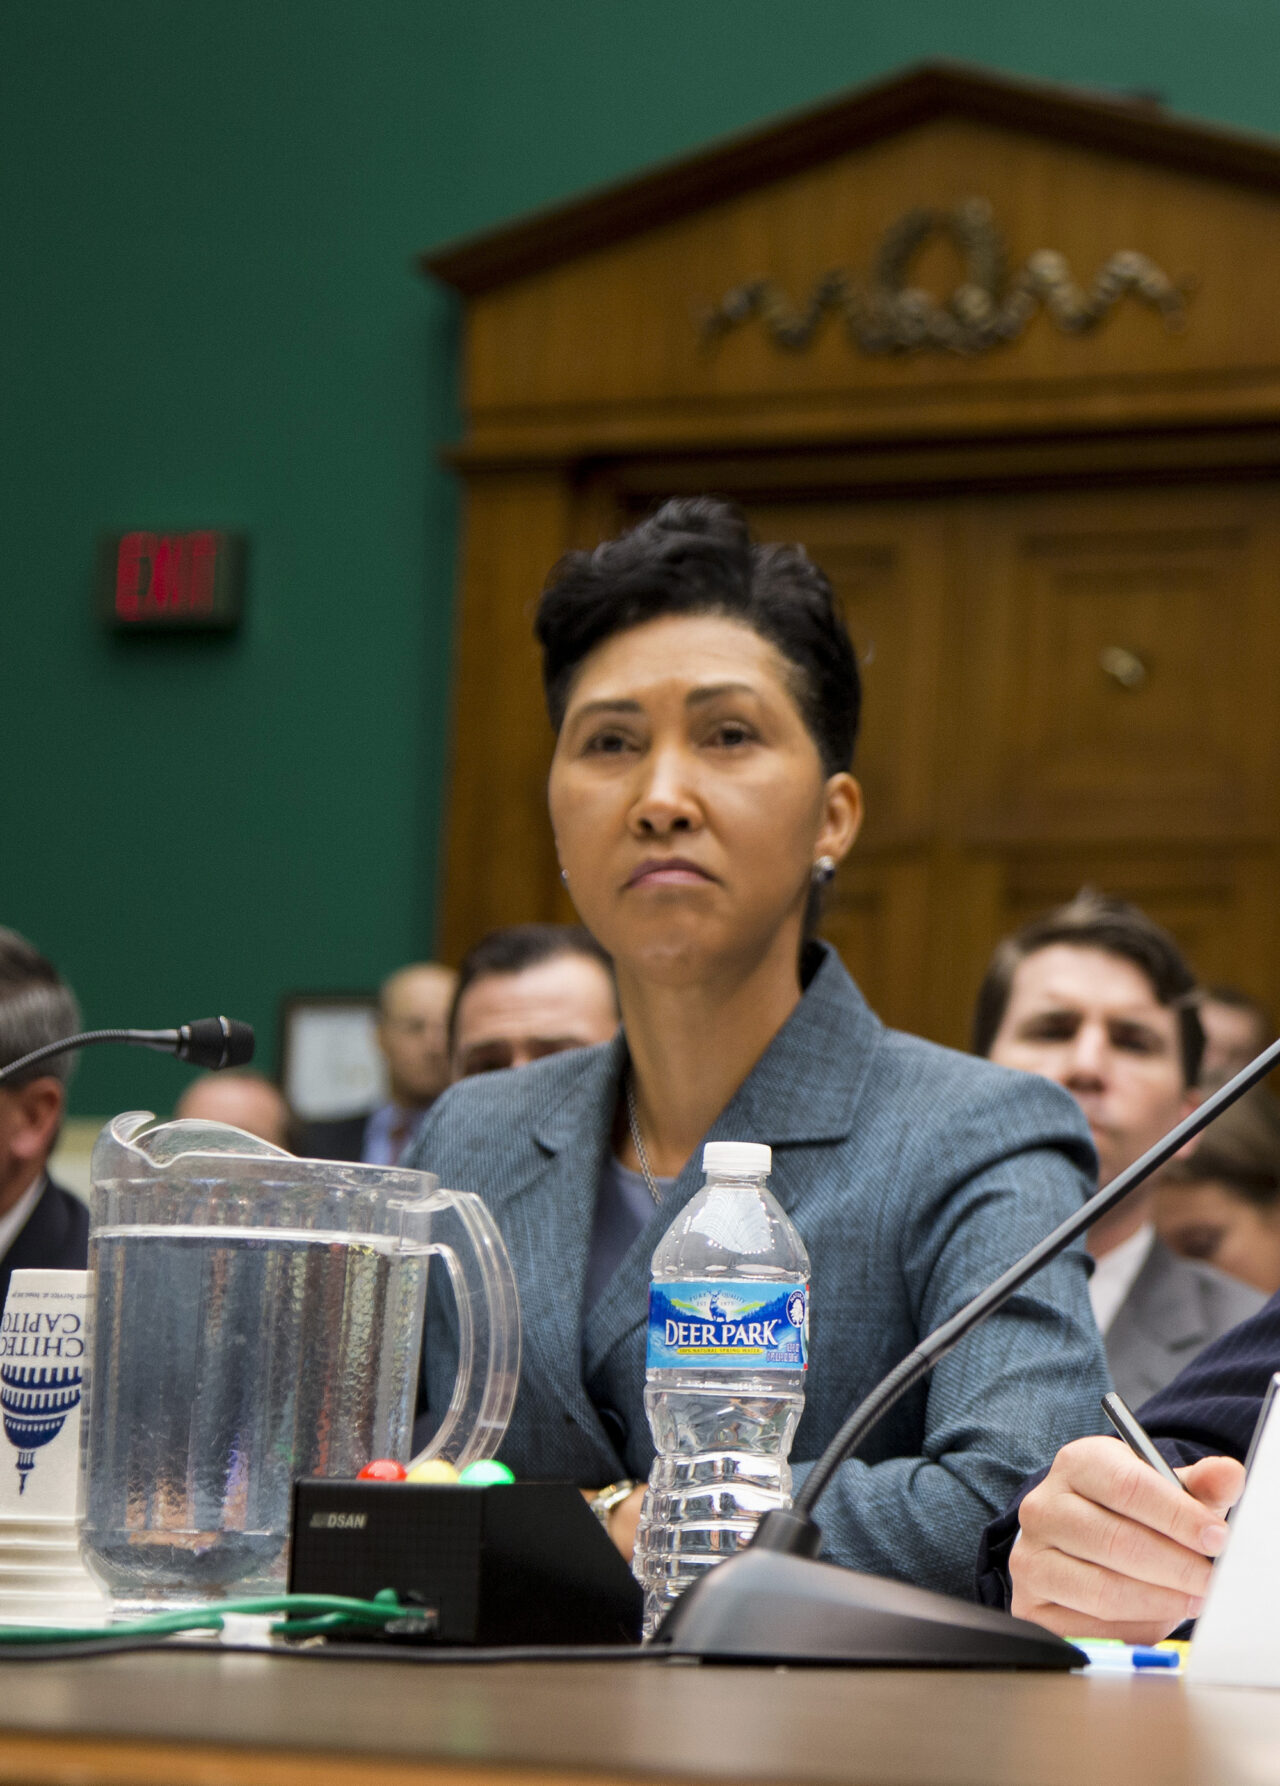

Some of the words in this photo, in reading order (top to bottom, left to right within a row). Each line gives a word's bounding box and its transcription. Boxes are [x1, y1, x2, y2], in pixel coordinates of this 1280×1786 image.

[115, 530, 217, 622] EXIT
[664, 1319, 721, 1346] DEER
[721, 1319, 779, 1346] PARK
[327, 1511, 367, 1529] DSAN
